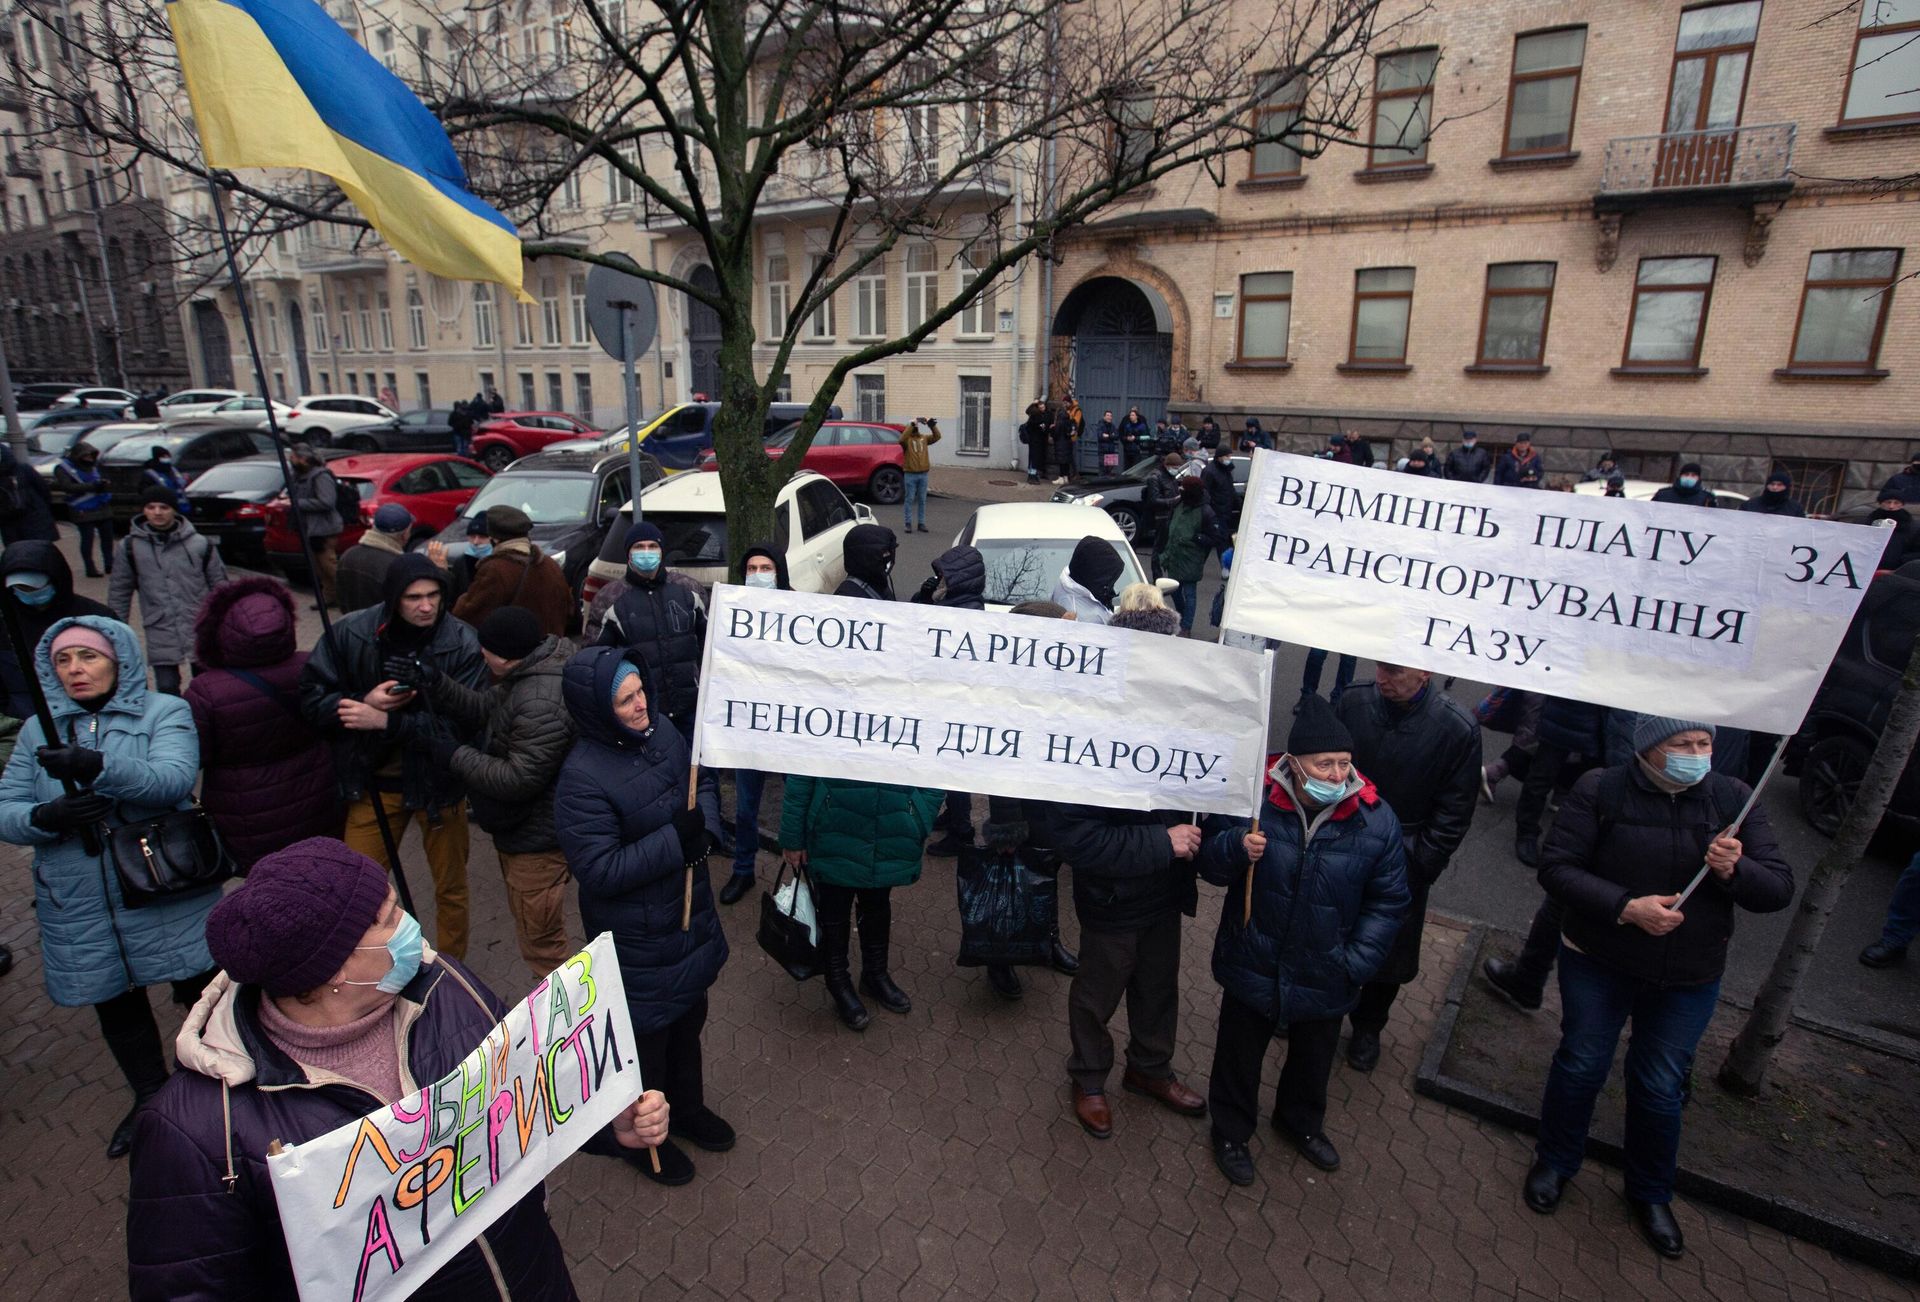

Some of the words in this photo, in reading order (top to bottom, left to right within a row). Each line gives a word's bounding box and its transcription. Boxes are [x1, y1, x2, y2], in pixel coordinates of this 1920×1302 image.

[1277, 475, 1500, 539] ВІДМІНІТЬ
[1532, 514, 1717, 567] ПЛАТУ
[1785, 544, 1863, 590] ЗА
[1263, 531, 1748, 645] ТРАНСПОРТУВАННЯ
[728, 607, 887, 652] ВИСОКІ
[927, 627, 1107, 676] ТАРИФИ
[1421, 617, 1551, 672] ГАЗУ.
[723, 699, 921, 751] ГЕНОЦИД
[936, 722, 1025, 759] ДЛЯ
[1045, 733, 1228, 784] НАРОДУ.
[352, 1008, 634, 1302] АФЕРИСТИ.
